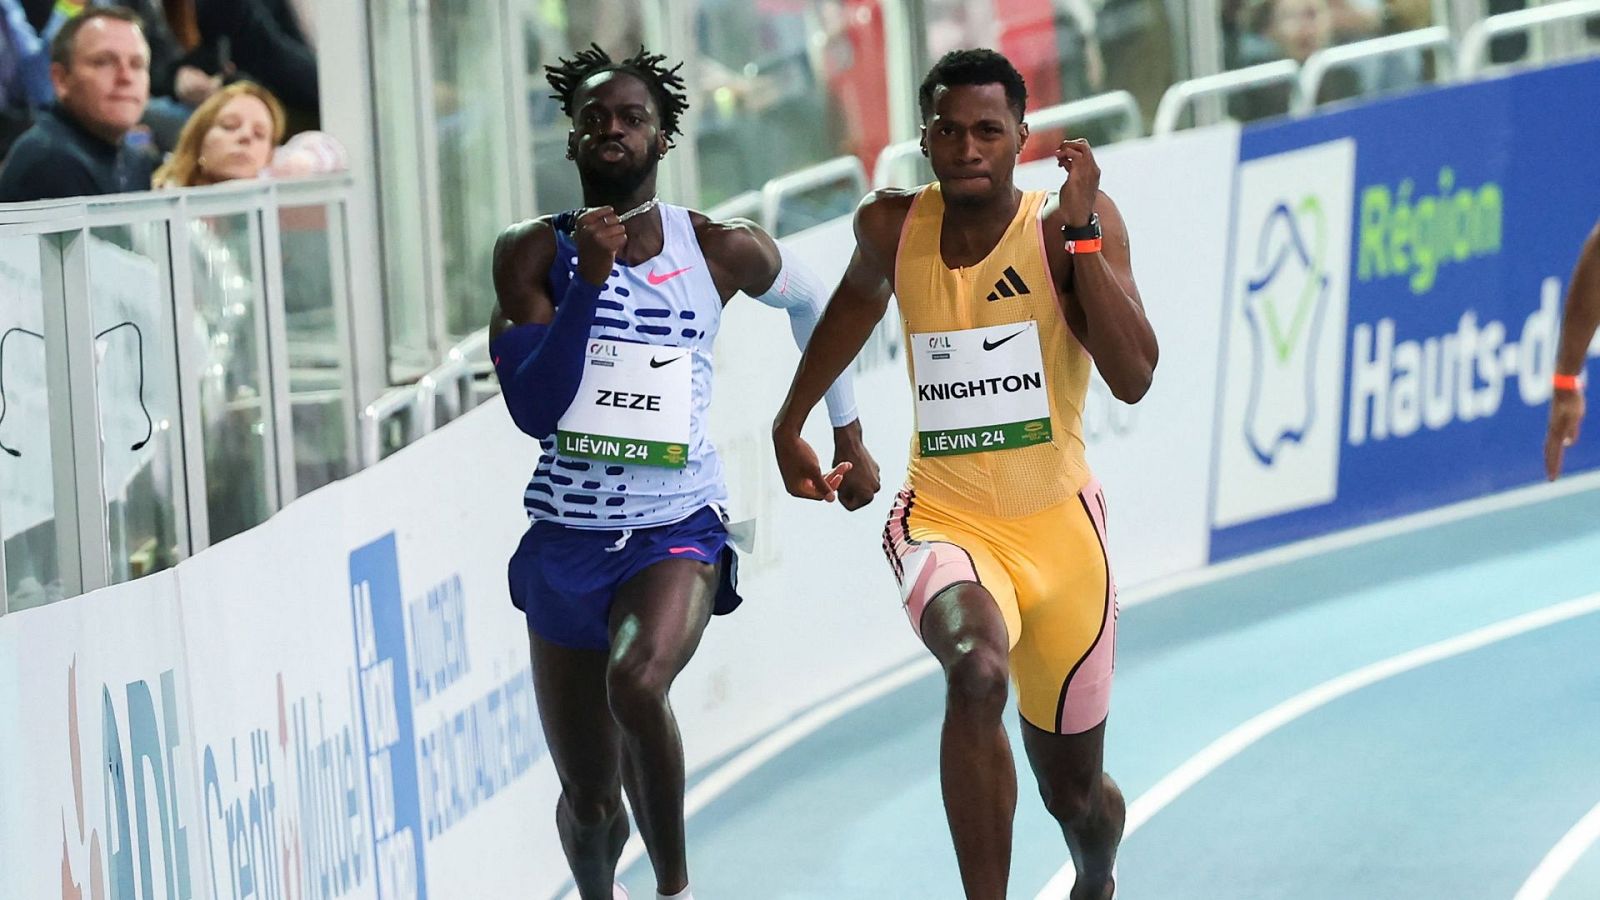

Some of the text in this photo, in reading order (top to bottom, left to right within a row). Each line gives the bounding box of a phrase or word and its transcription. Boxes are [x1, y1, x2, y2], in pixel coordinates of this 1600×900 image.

[1358, 166, 1502, 293] Région
[1348, 277, 1564, 446] Hauts-d
[595, 389, 661, 412] ZEZE
[919, 372, 1042, 402] KNIGHTON
[566, 435, 620, 457] LIÉVIN
[625, 442, 648, 459] 24
[927, 432, 977, 452] LIÉVIN
[981, 430, 1005, 447] 24
